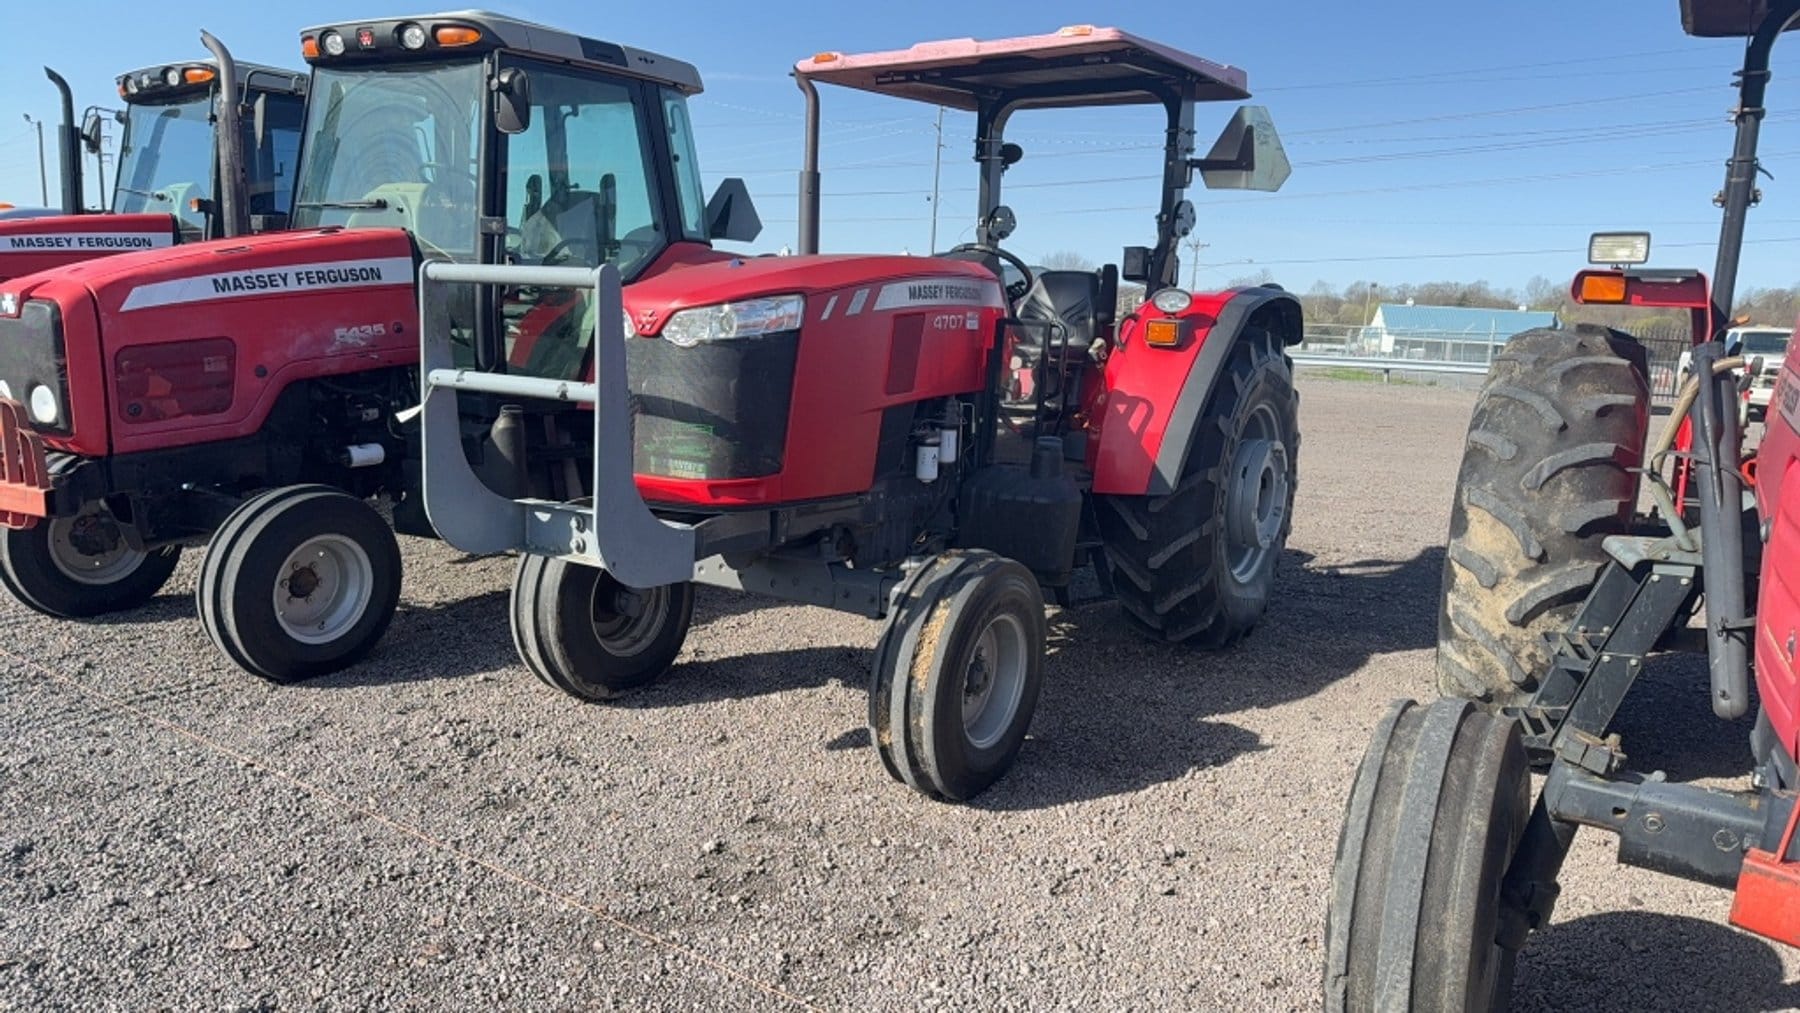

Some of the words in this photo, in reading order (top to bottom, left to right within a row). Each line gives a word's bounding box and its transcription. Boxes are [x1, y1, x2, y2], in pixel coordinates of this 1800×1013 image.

[10, 237, 72, 248] MASSEY
[78, 236, 152, 248] FERGUSON
[212, 273, 289, 293] MASSEY
[296, 267, 382, 286] FERGUSON
[908, 285, 942, 300] MASSEY
[933, 315, 963, 329] 4707
[333, 323, 386, 342] 5435
